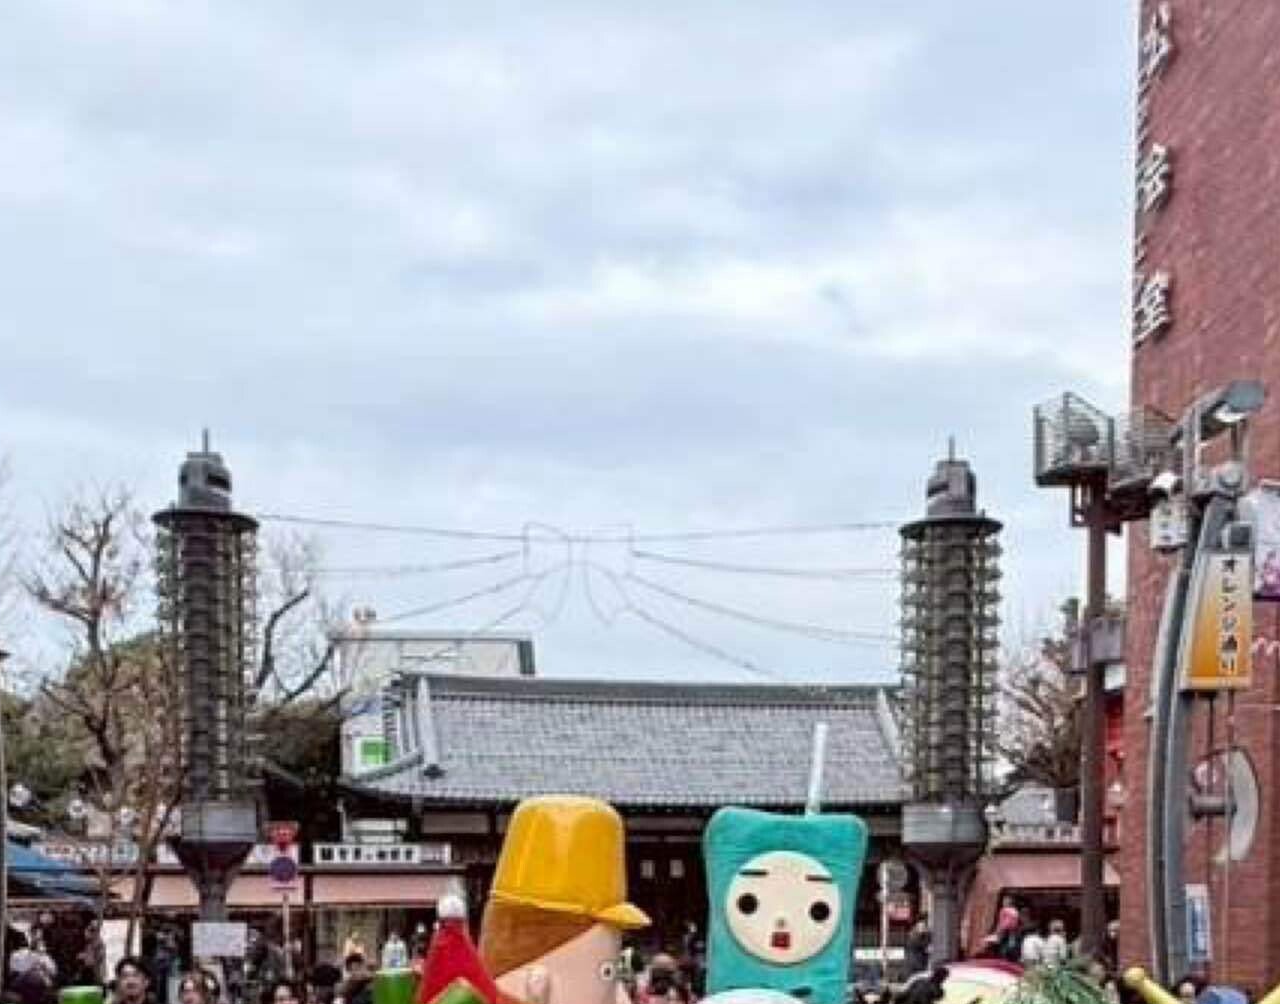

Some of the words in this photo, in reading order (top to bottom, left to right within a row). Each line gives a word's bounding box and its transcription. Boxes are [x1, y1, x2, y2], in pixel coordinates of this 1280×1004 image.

[1221, 558, 1239, 671] オレンジ通り
